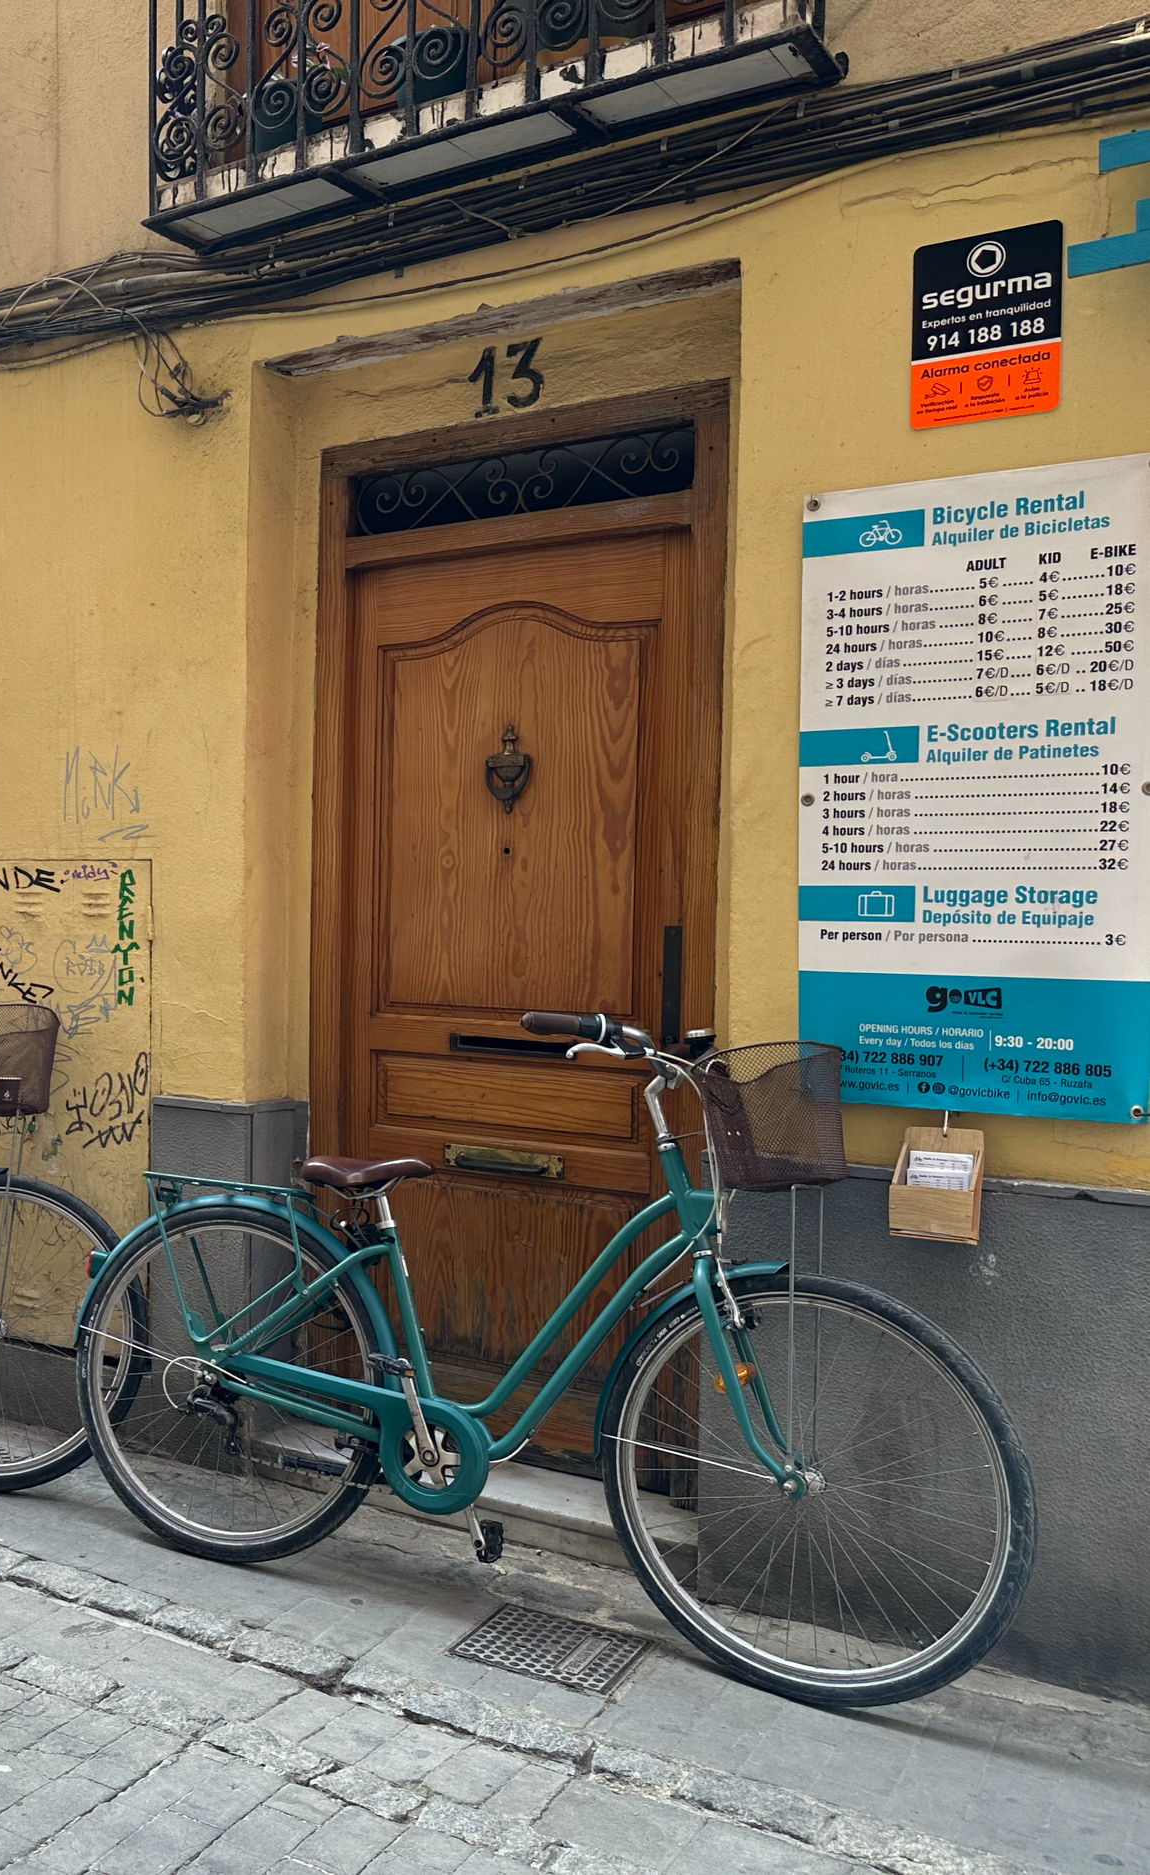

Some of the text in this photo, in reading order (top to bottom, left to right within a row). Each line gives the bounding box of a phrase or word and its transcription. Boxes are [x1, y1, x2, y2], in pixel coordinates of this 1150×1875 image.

[922, 270, 1052, 310] segurma
[922, 298, 1052, 329] Expertos en tranquilidad
[927, 317, 1045, 352] 914 188 188
[920, 350, 1051, 380] Alarma conectada
[468, 337, 544, 418] 13
[932, 490, 1085, 526] Bicycle Rental
[931, 516, 1111, 546] Alquiler de Bicicletas
[966, 544, 1136, 572] ADULT KID E-BIKE
[827, 563, 1136, 602] 1-2 hours horas 5€ 4€ 10€
[827, 583, 1136, 621] 3-4 hours horas 6€ 5€ 18€
[826, 602, 1135, 637] 5-10 hours horas 8€ 7€ 25€
[825, 621, 1135, 655] 24 hours horas 10€ 8€ 30€
[825, 640, 1135, 673] 2 days días 15€ 12€ 50€
[836, 659, 1134, 691] 3 days días 7€/D 6€/D 20€/D
[836, 678, 1134, 708] 7 days días 6€/D 5€/D 18€/D
[926, 716, 1116, 742] E-Scooters Rental
[926, 744, 1100, 765] Alquiler de Patinetes
[823, 763, 1131, 784] 1 hour hora 10€
[823, 782, 1131, 802] 2 hours horas 14€
[822, 801, 1130, 819] 3 hours horas 18€
[822, 820, 1130, 836] 4 hours horas 22€
[821, 839, 1129, 854] 5-10 hours horas 27€
[821, 858, 1129, 871] 24 hours horas 32€
[922, 885, 1099, 907] Luggage Storage
[922, 909, 1095, 929] Depósito de Equipaje
[820, 928, 1127, 946] Per person Por persona 3€
[859, 1023, 984, 1038] OPENING HOURS HORARIO
[858, 1036, 975, 1051] Every day Todos los días
[994, 1035, 1074, 1051] 9:30 20:00
[840, 1050, 944, 1067] 34) 722 886 907
[983, 1057, 1112, 1078] (+34) 722 886 805
[844, 1065, 937, 1079] Roteros 11 Serranos
[1001, 1074, 1093, 1089] C/ Cuba 65 Ruzafa
[840, 1079, 900, 1093] ww.govlc.es
[947, 1085, 1010, 1101] @govlcbike
[1027, 1090, 1106, 1106] info@govlc.es
